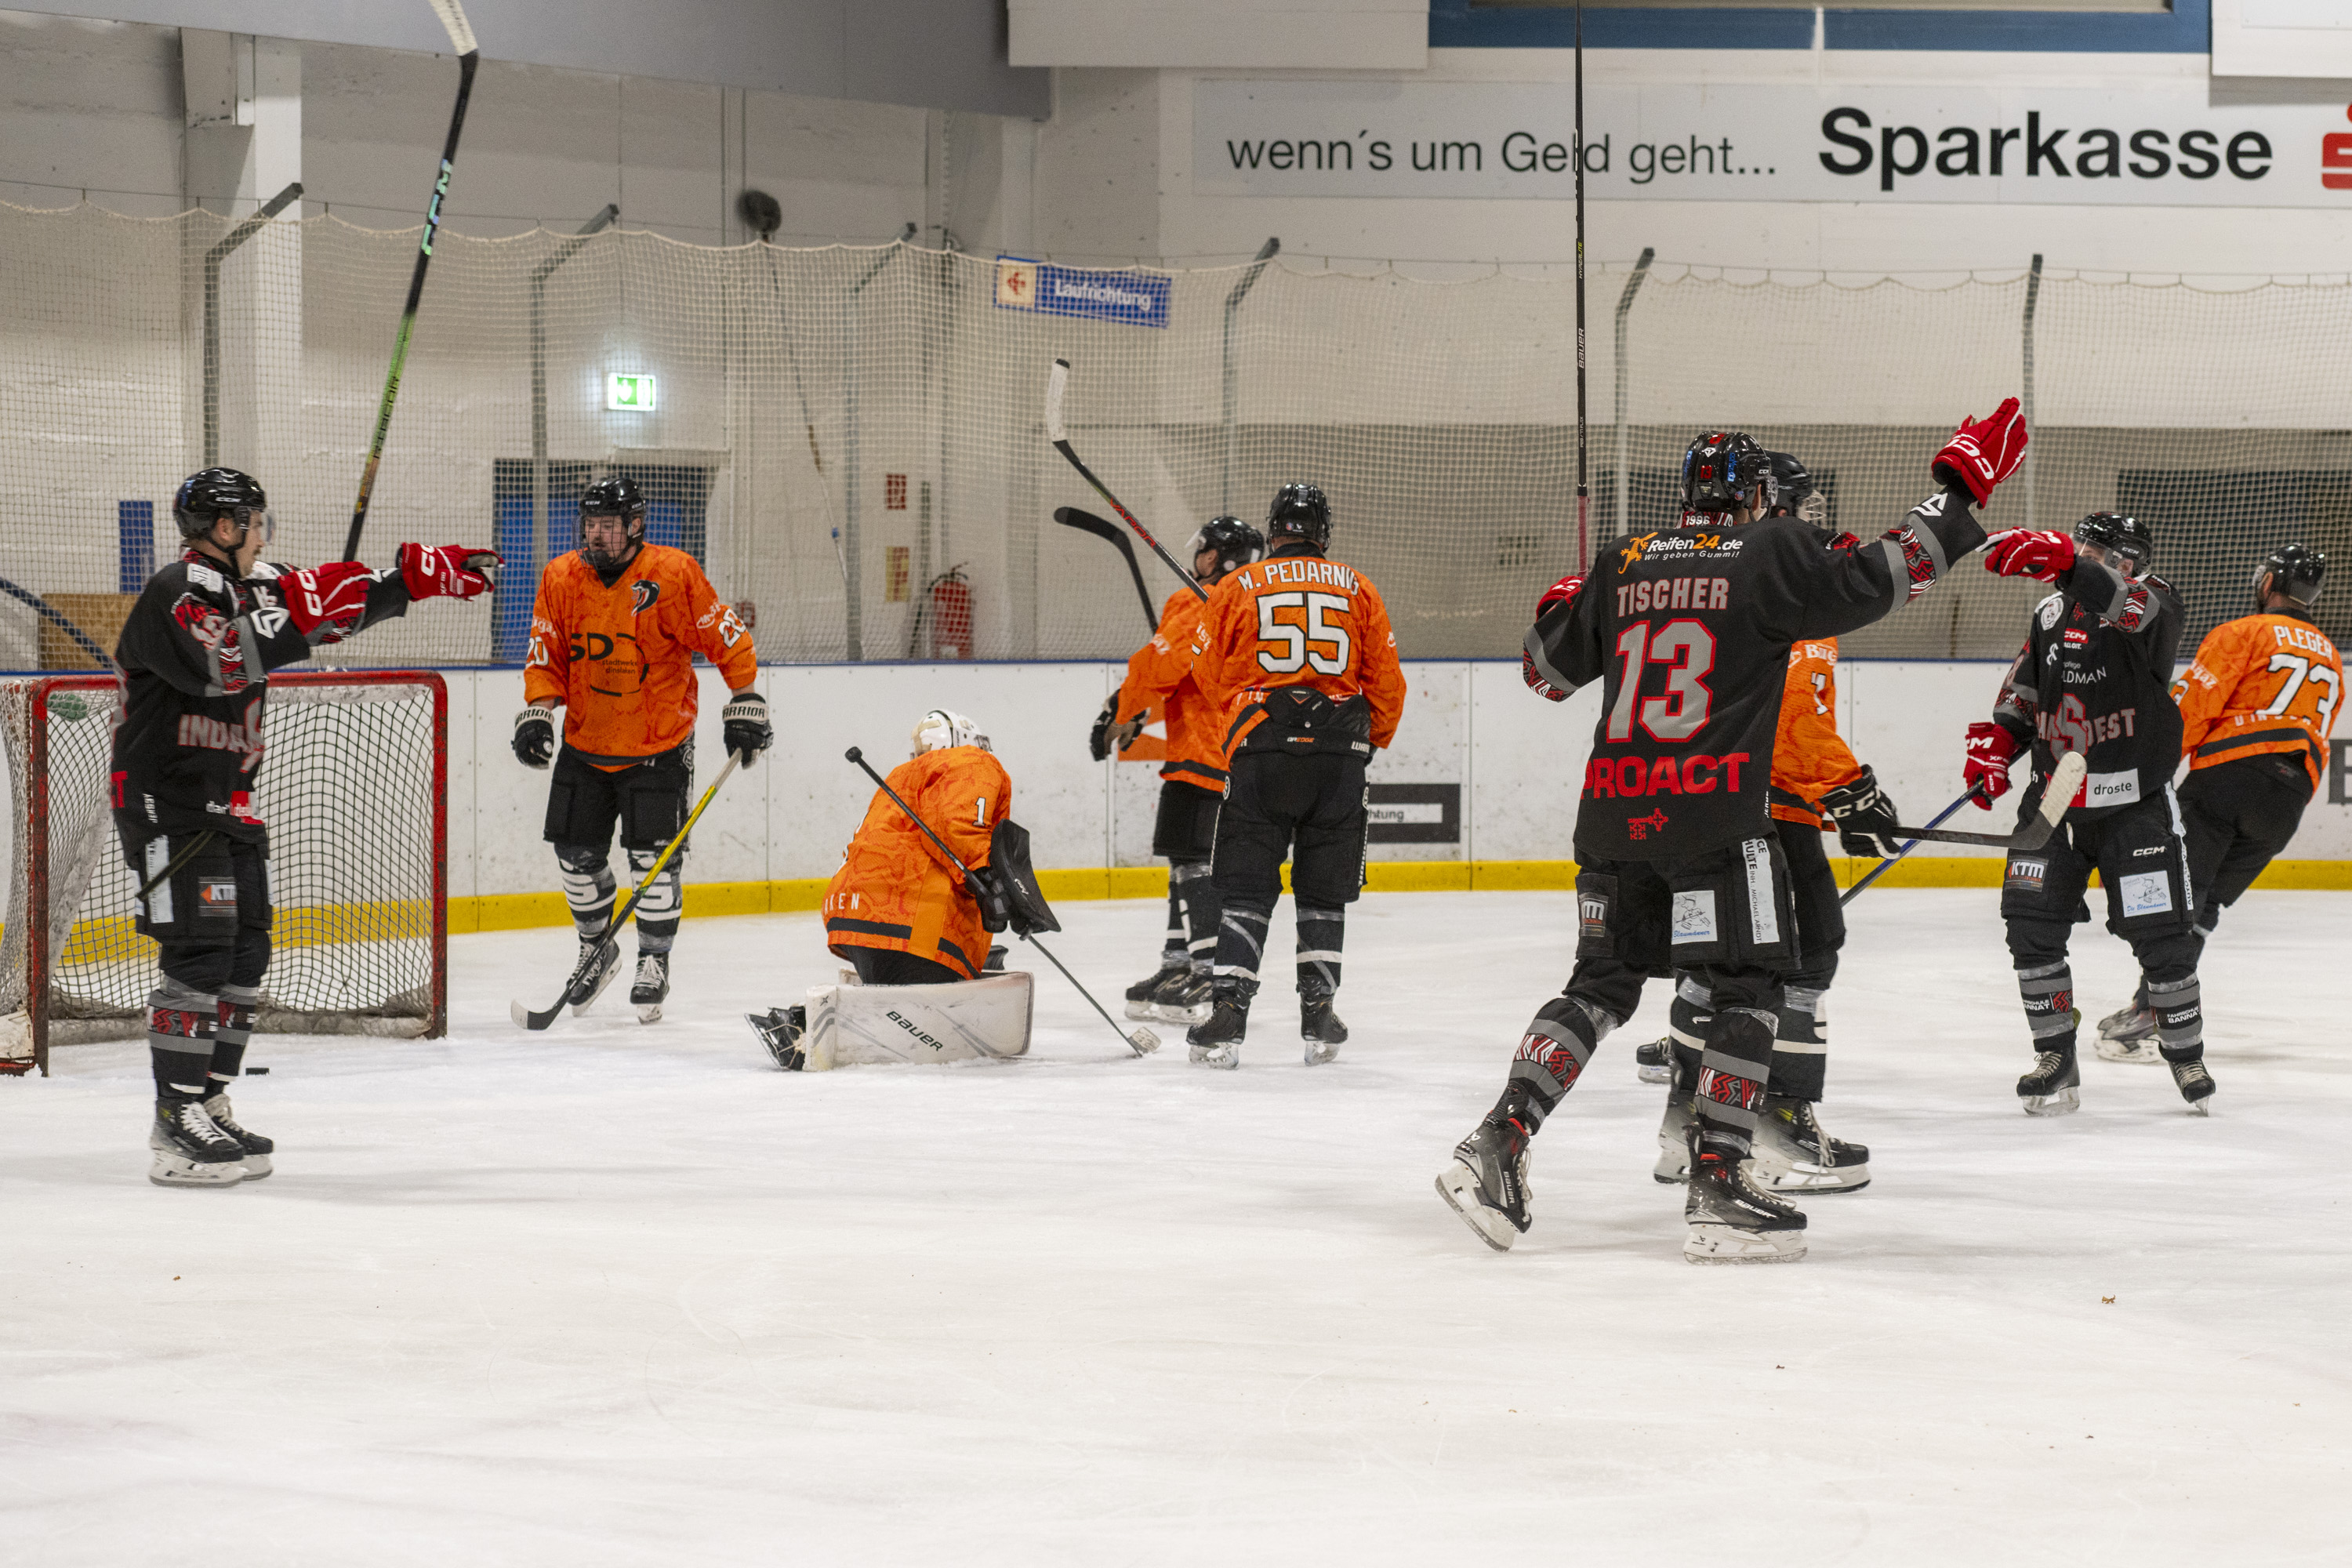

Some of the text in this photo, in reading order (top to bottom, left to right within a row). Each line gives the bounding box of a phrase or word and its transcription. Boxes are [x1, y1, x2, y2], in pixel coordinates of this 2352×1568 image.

[1411, 140, 1483, 172] um
[1501, 132, 1610, 173] Geld
[1629, 134, 1776, 184] geht...
[1818, 107, 2274, 192] Sparkasse
[1054, 278, 1152, 312] Laufrichtung
[1700, 465, 1712, 479] 13
[1109, 495, 1156, 550] VAPOR
[1685, 514, 1711, 526] 1996
[1646, 532, 1744, 553] Reifen24.de
[1662, 550, 1695, 561] geben
[1698, 550, 1740, 559] Gummi!
[1237, 569, 1262, 593] M.
[1617, 577, 1730, 618] TISCHER
[1255, 590, 1351, 677] 55
[2273, 624, 2333, 664] PLEGER
[1606, 617, 1717, 744] 13
[2255, 652, 2340, 742] 73
[515, 707, 553, 729] ARRIOR
[722, 706, 766, 720] ARRIOR
[1579, 752, 1751, 801] PROACT
[2093, 781, 2132, 796] droste
[972, 796, 986, 828] 1
[2132, 845, 2166, 857] CCM
[2011, 861, 2045, 878] KTM
[1751, 888, 1759, 918] MICHAEL
[1754, 919, 1762, 942] ARNDT
[2024, 1003, 2051, 1011] ANNAT
[885, 1010, 944, 1053] BAUER
[1503, 1171, 1515, 1204] BAUER
[1734, 1199, 1778, 1219] BAUER
